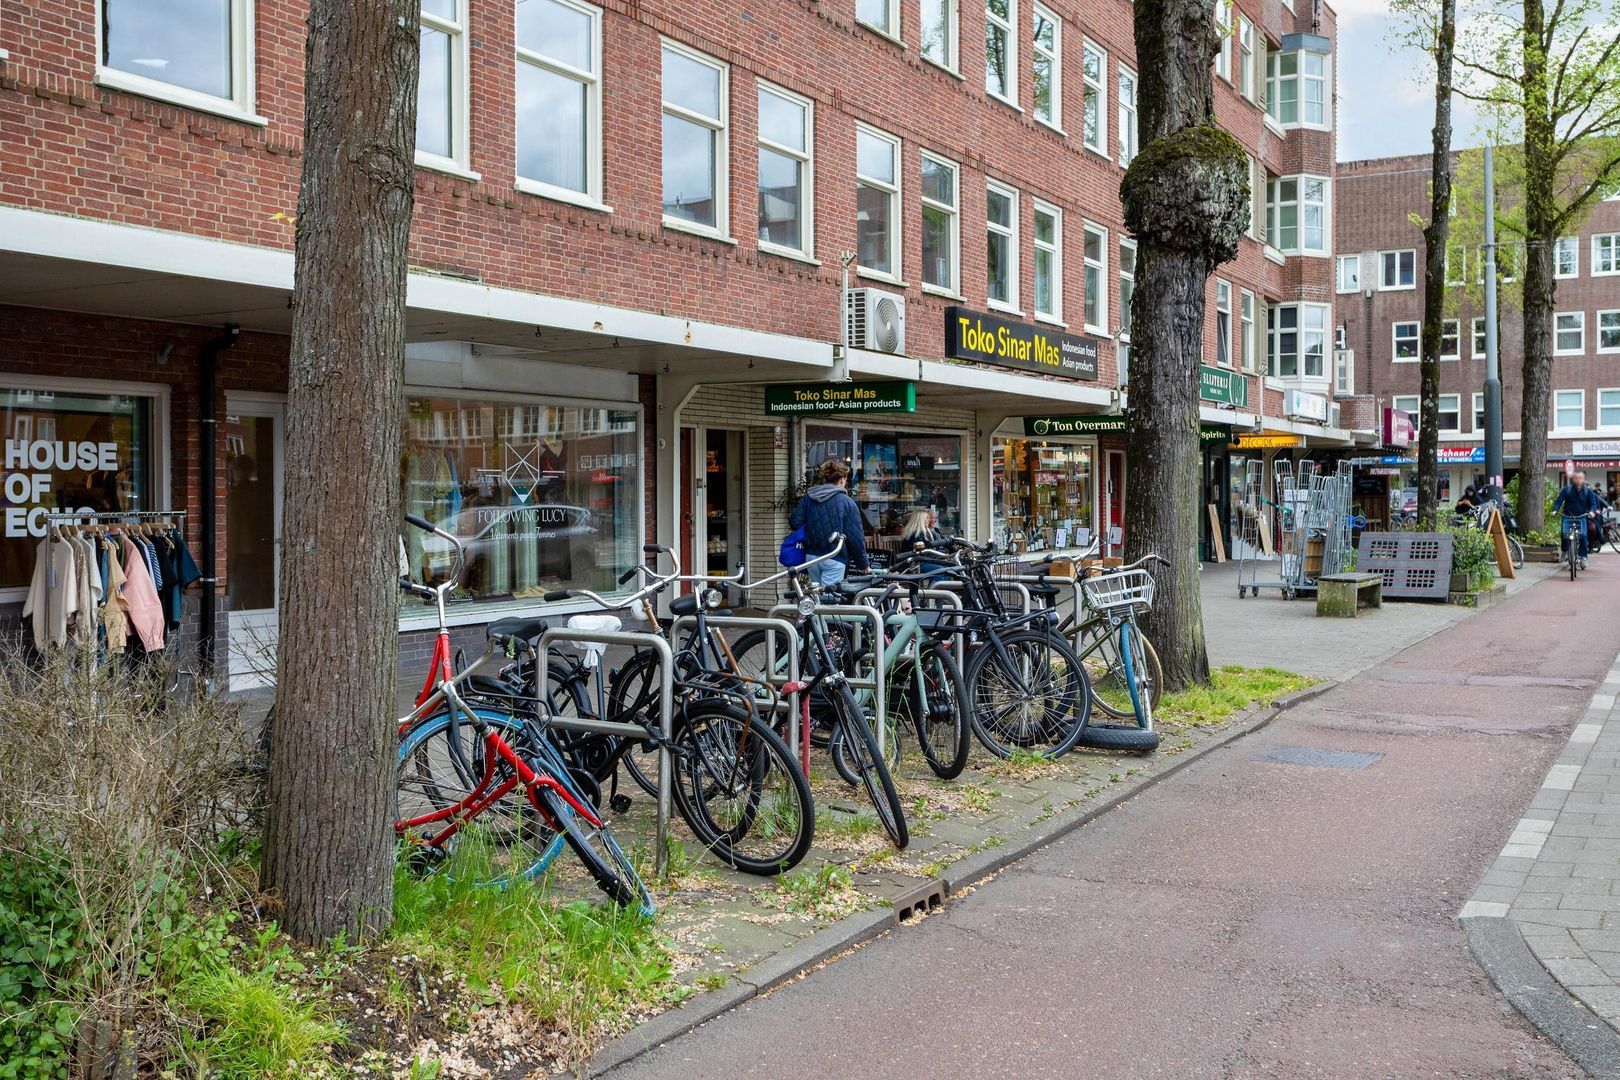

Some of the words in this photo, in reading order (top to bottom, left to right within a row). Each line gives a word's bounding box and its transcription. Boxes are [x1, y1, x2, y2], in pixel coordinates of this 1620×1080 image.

[959, 317, 995, 354] Toko
[998, 326, 1032, 361] Sinar
[1034, 334, 1060, 367] Mas
[1061, 340, 1086, 356] Indonesian
[1085, 344, 1096, 358] food
[1062, 356, 1075, 368] Asian
[1075, 359, 1094, 372] products
[794, 390, 820, 401] Toko
[822, 389, 851, 401] Sinar
[853, 388, 876, 399] Mas
[771, 403, 814, 411] Indonesian
[863, 399, 901, 410] products
[1052, 421, 1073, 431] Ton
[1201, 431, 1226, 440] Spirits
[5, 439, 118, 471] HOUSE
[4, 473, 52, 504] OF
[478, 509, 539, 523] FOLLOWING
[541, 509, 566, 522] LUCY
